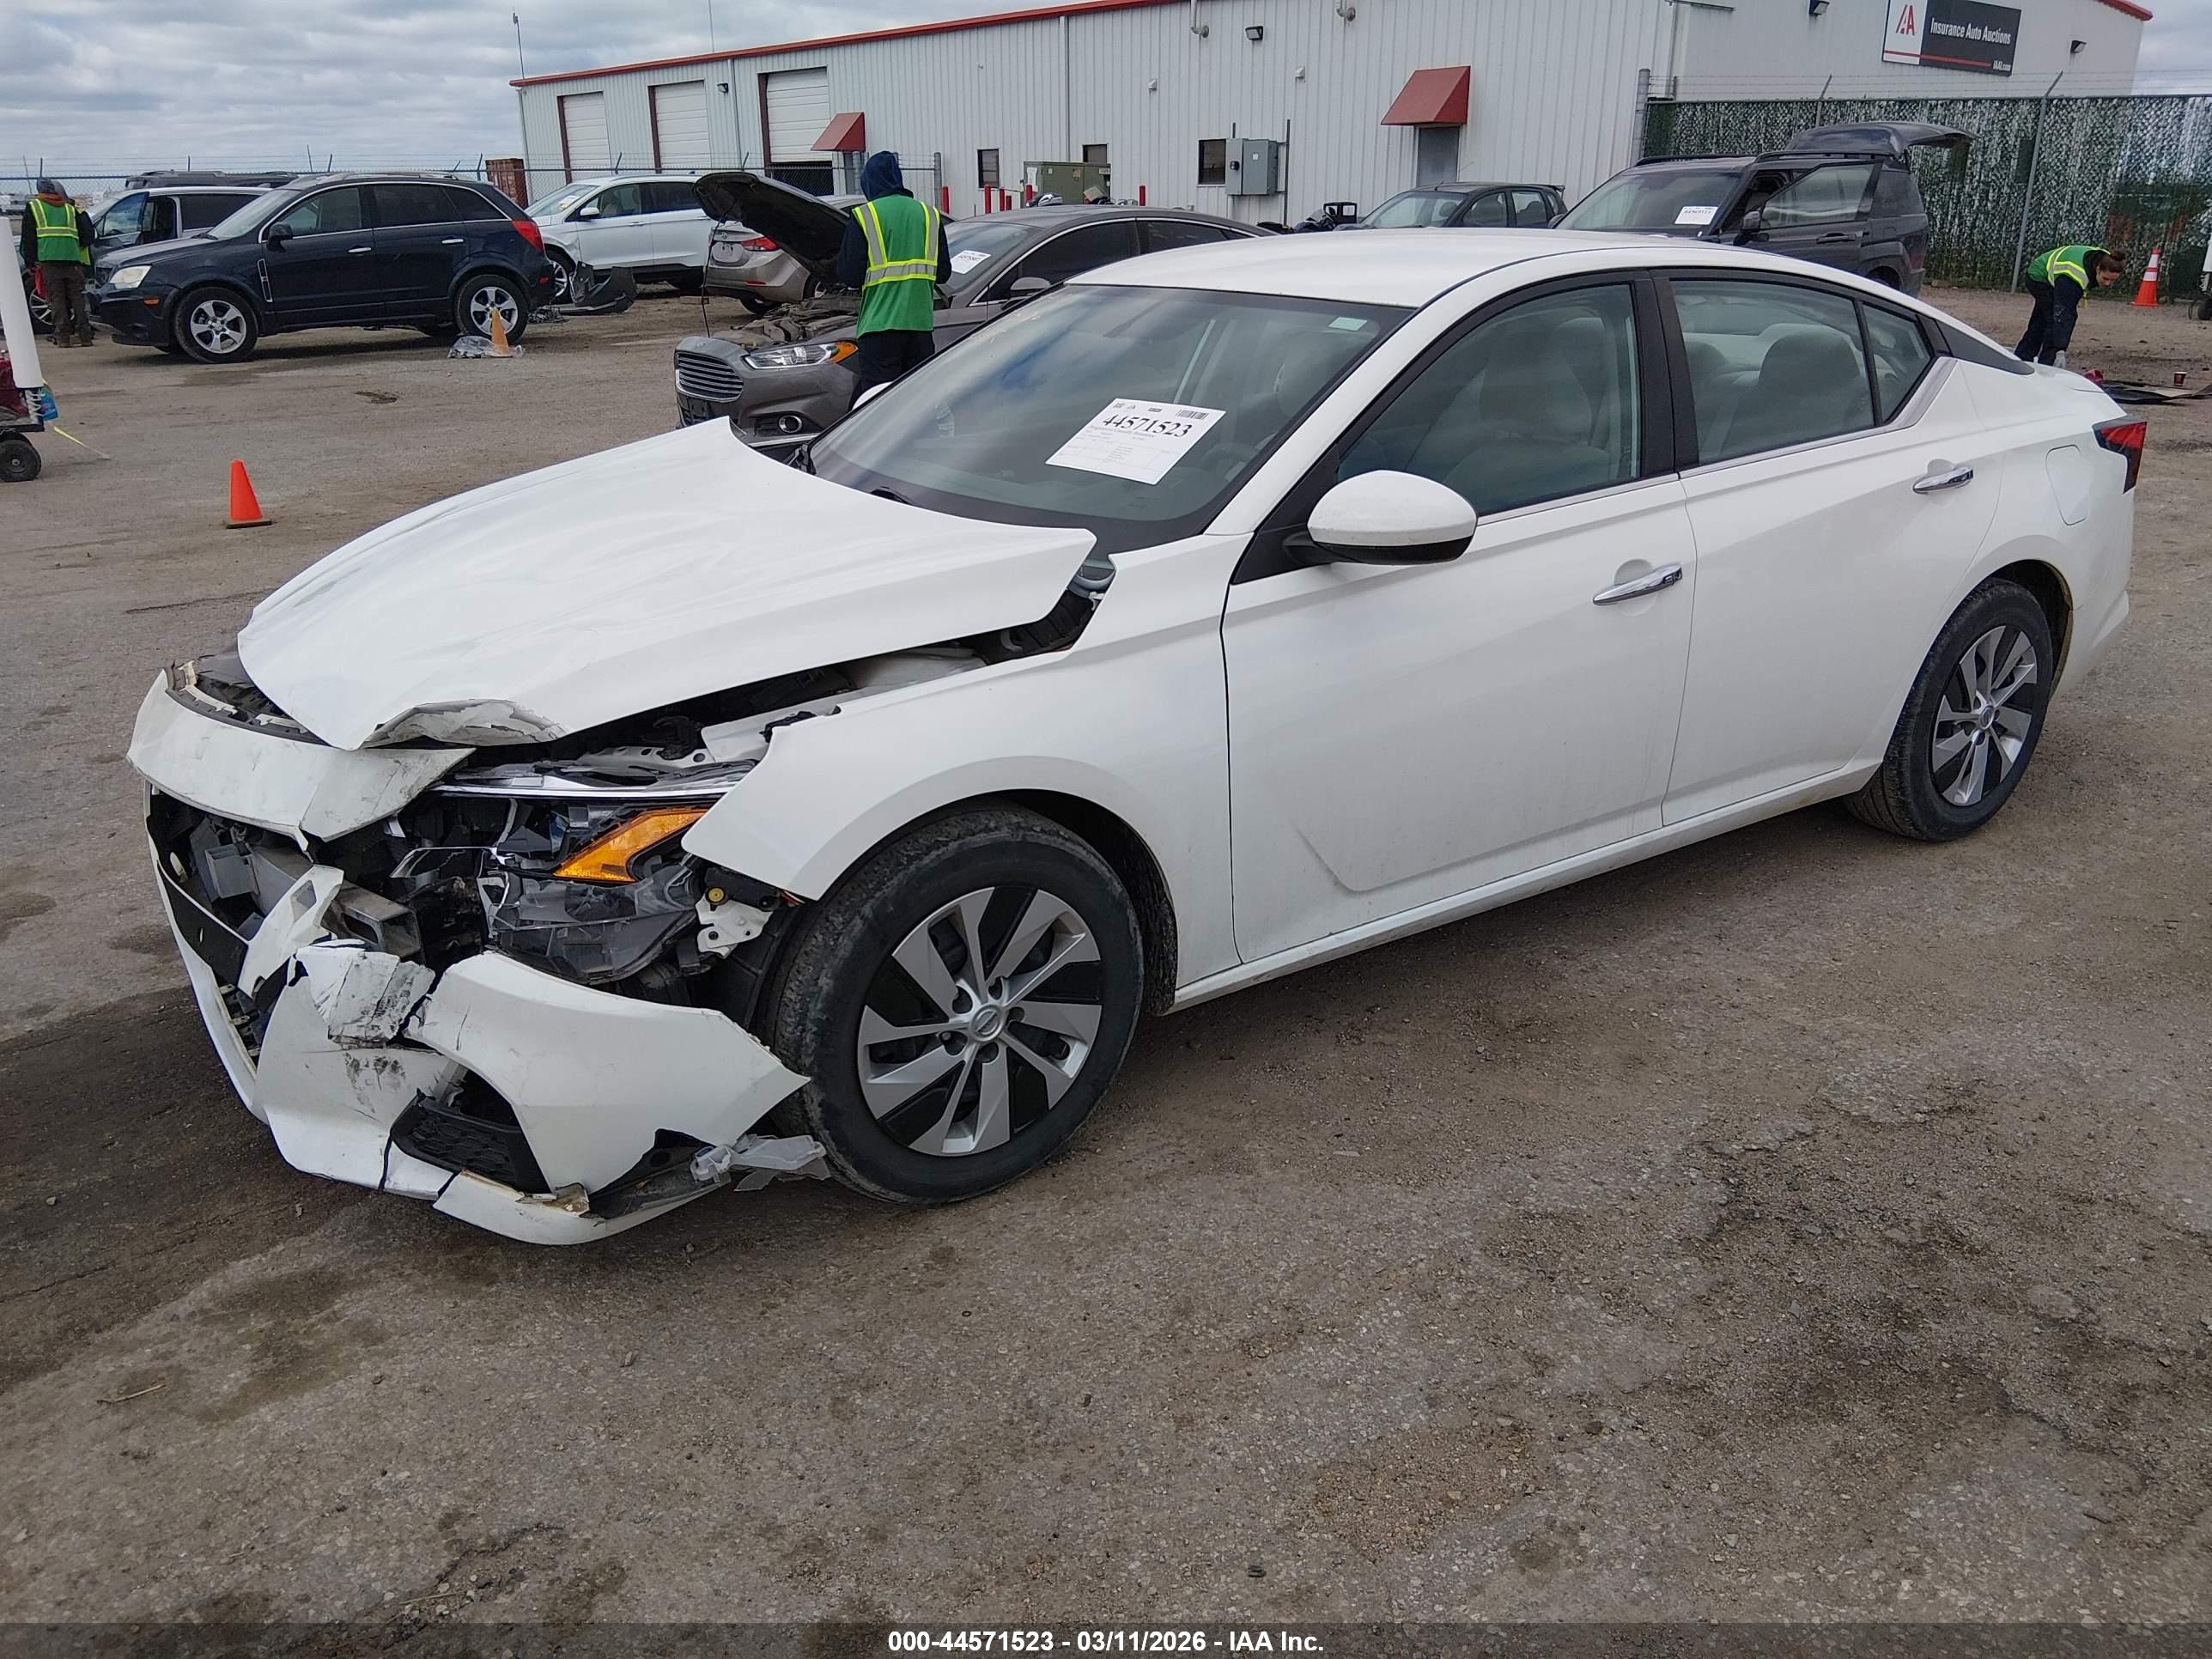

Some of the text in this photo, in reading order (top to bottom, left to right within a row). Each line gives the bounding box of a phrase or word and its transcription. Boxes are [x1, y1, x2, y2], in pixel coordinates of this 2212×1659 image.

[1930, 17, 2012, 45] Insurance Auto Auctions
[1103, 413, 1192, 438] 44571523
